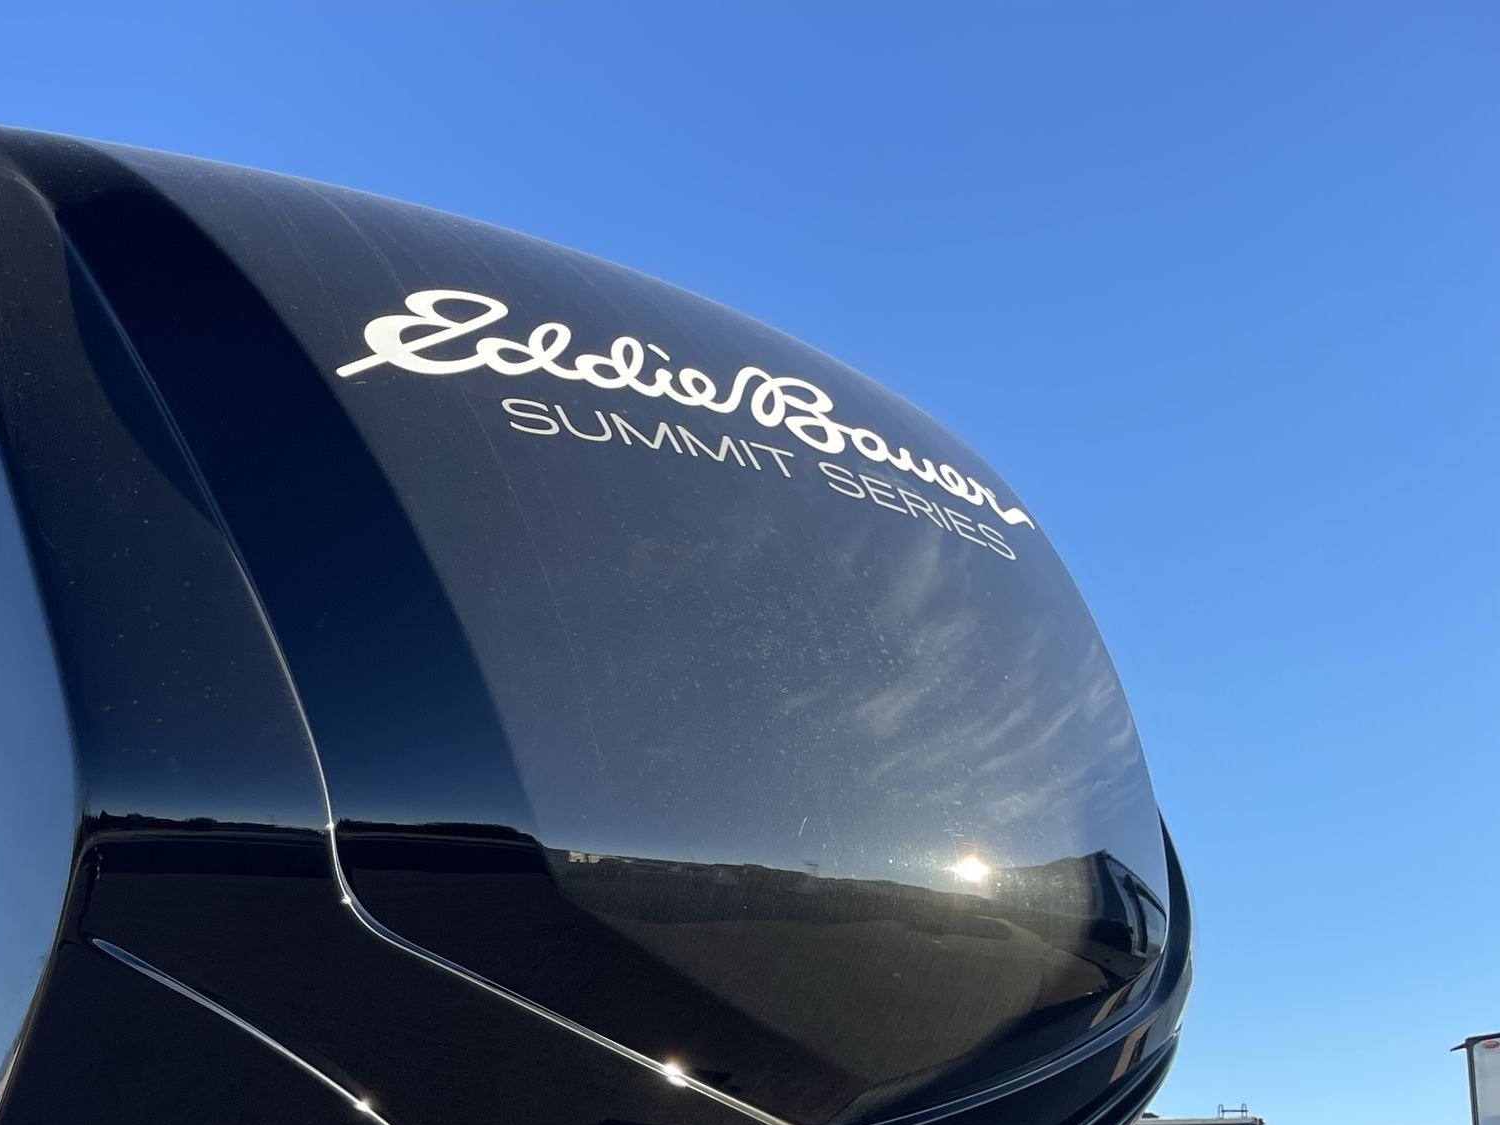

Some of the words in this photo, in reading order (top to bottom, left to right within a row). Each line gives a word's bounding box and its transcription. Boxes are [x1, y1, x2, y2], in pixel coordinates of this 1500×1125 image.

[336, 290, 725, 413] Eddie
[722, 366, 1035, 529] Bauer
[501, 398, 794, 478] SUMMIT
[818, 461, 1017, 560] SERIES
